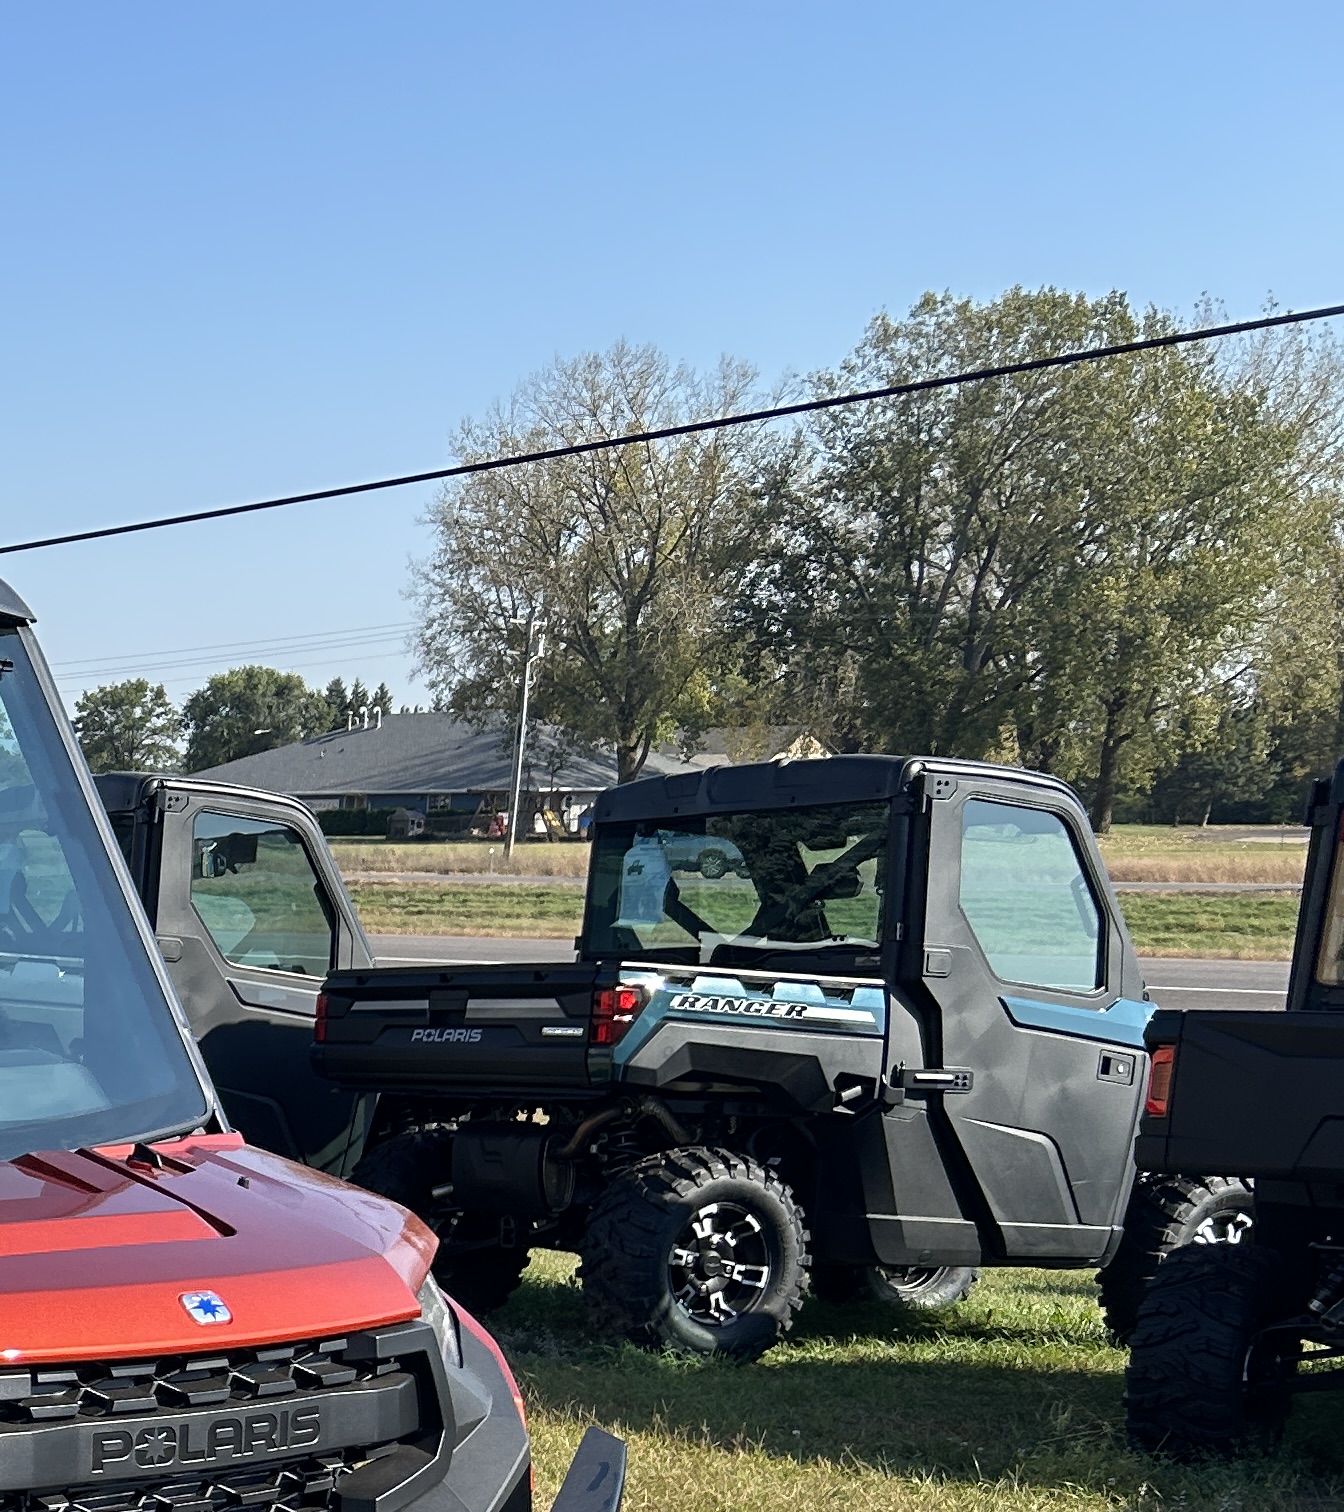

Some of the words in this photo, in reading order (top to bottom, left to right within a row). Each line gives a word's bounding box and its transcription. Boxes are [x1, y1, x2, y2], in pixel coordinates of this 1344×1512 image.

[676, 994, 808, 1018] RANGER
[411, 1028, 483, 1042] POLARIS
[90, 1405, 321, 1474] POLARIS
